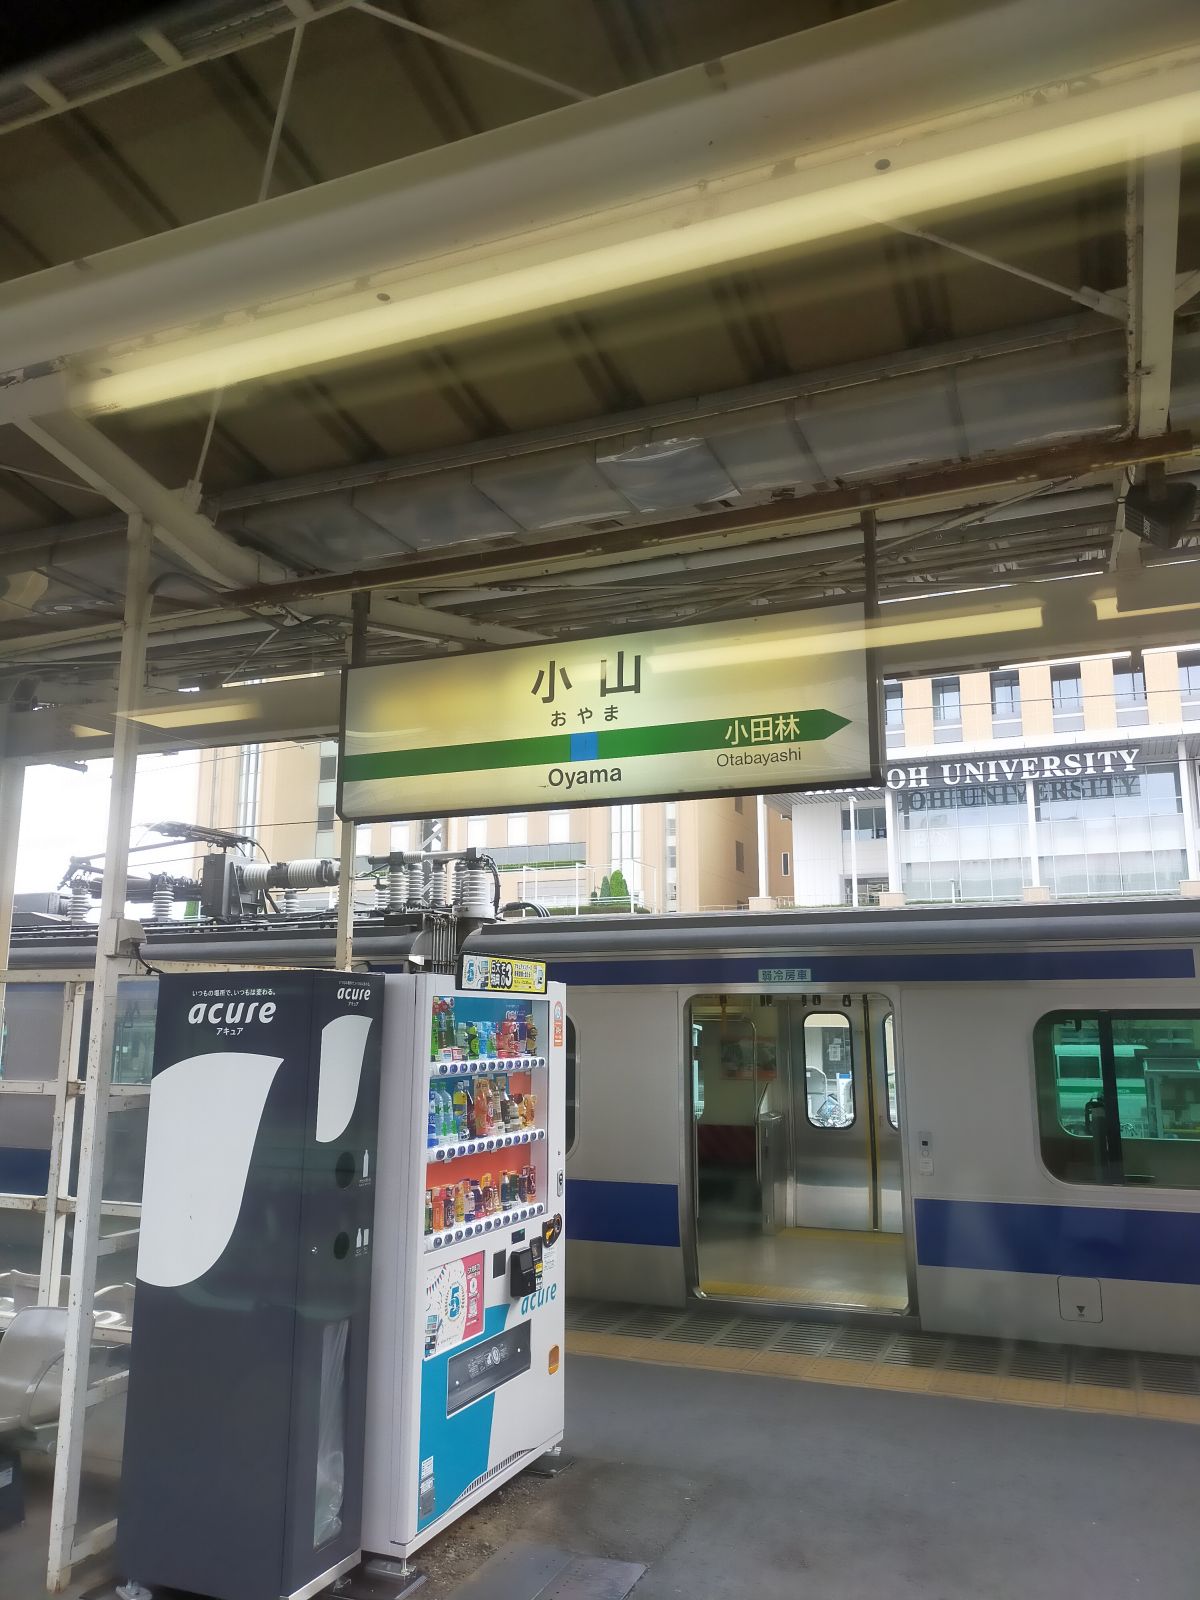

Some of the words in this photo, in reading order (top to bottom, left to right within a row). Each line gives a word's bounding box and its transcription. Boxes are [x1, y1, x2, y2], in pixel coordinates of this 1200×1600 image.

[531, 651, 641, 703] 小山
[550, 704, 620, 728] おやま
[725, 714, 800, 745] 小田林
[717, 747, 802, 768] Otabayashi
[940, 748, 1140, 785] UNIVERSITY
[547, 765, 622, 790] Oyama
[762, 969, 808, 981] 弱冷房車
[337, 987, 371, 1001] acure
[188, 1002, 277, 1024] acure
[216, 1027, 243, 1036] アキュア
[521, 1282, 557, 1316] acure
